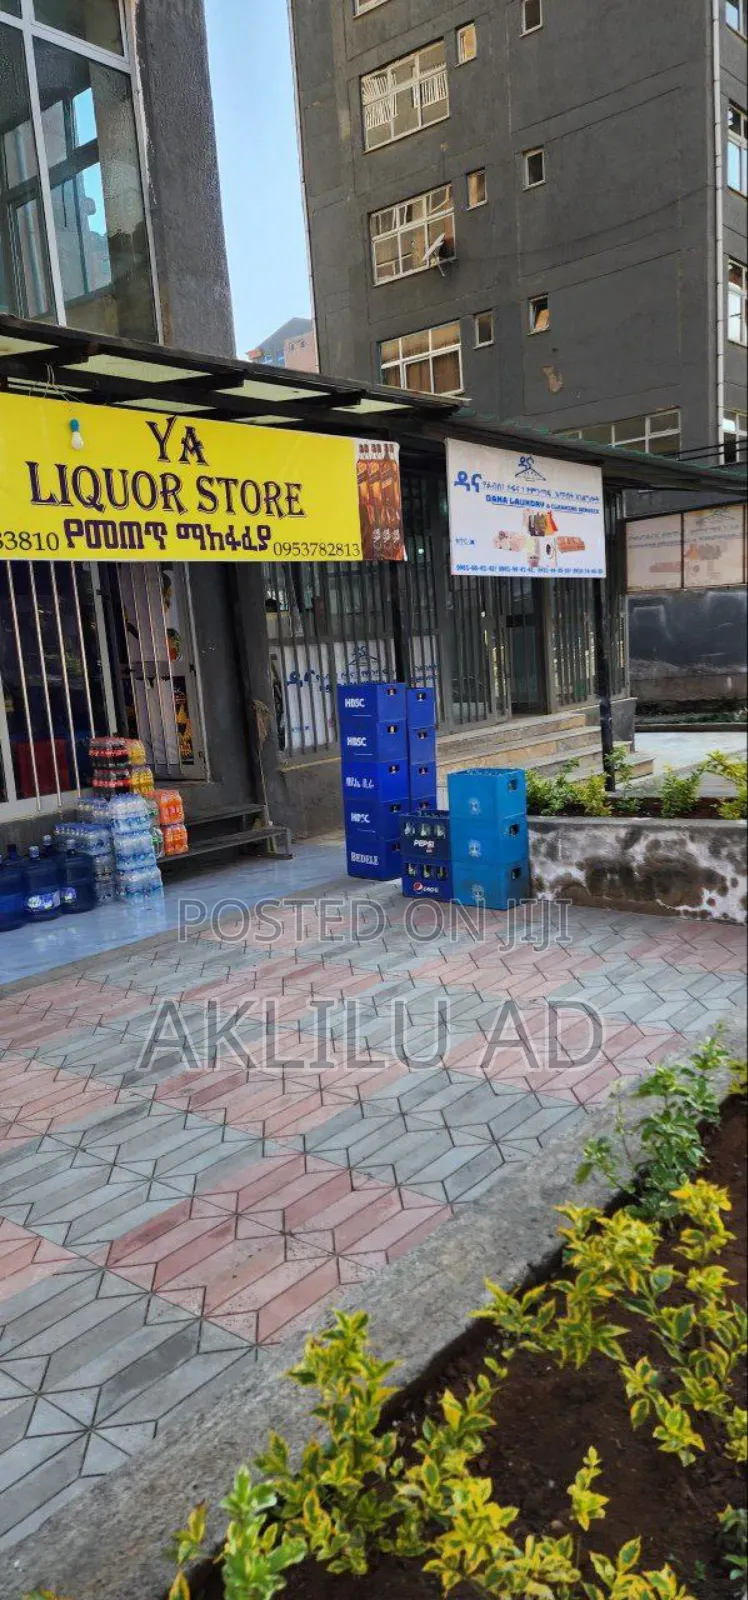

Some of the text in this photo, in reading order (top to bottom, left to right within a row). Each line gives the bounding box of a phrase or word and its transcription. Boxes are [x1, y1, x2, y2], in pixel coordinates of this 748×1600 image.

[146, 414, 209, 466] YA
[25, 460, 308, 519] LIQUOR STORE
[453, 470, 482, 493] ዳና
[509, 497, 545, 508] LAUNDRY
[0, 530, 60, 551] 3810
[63, 518, 272, 552] የመጠጥ ማከፋፈያ
[272, 541, 361, 557] 0953782813
[344, 698, 366, 708] HBSC
[346, 736, 367, 747] HBSC
